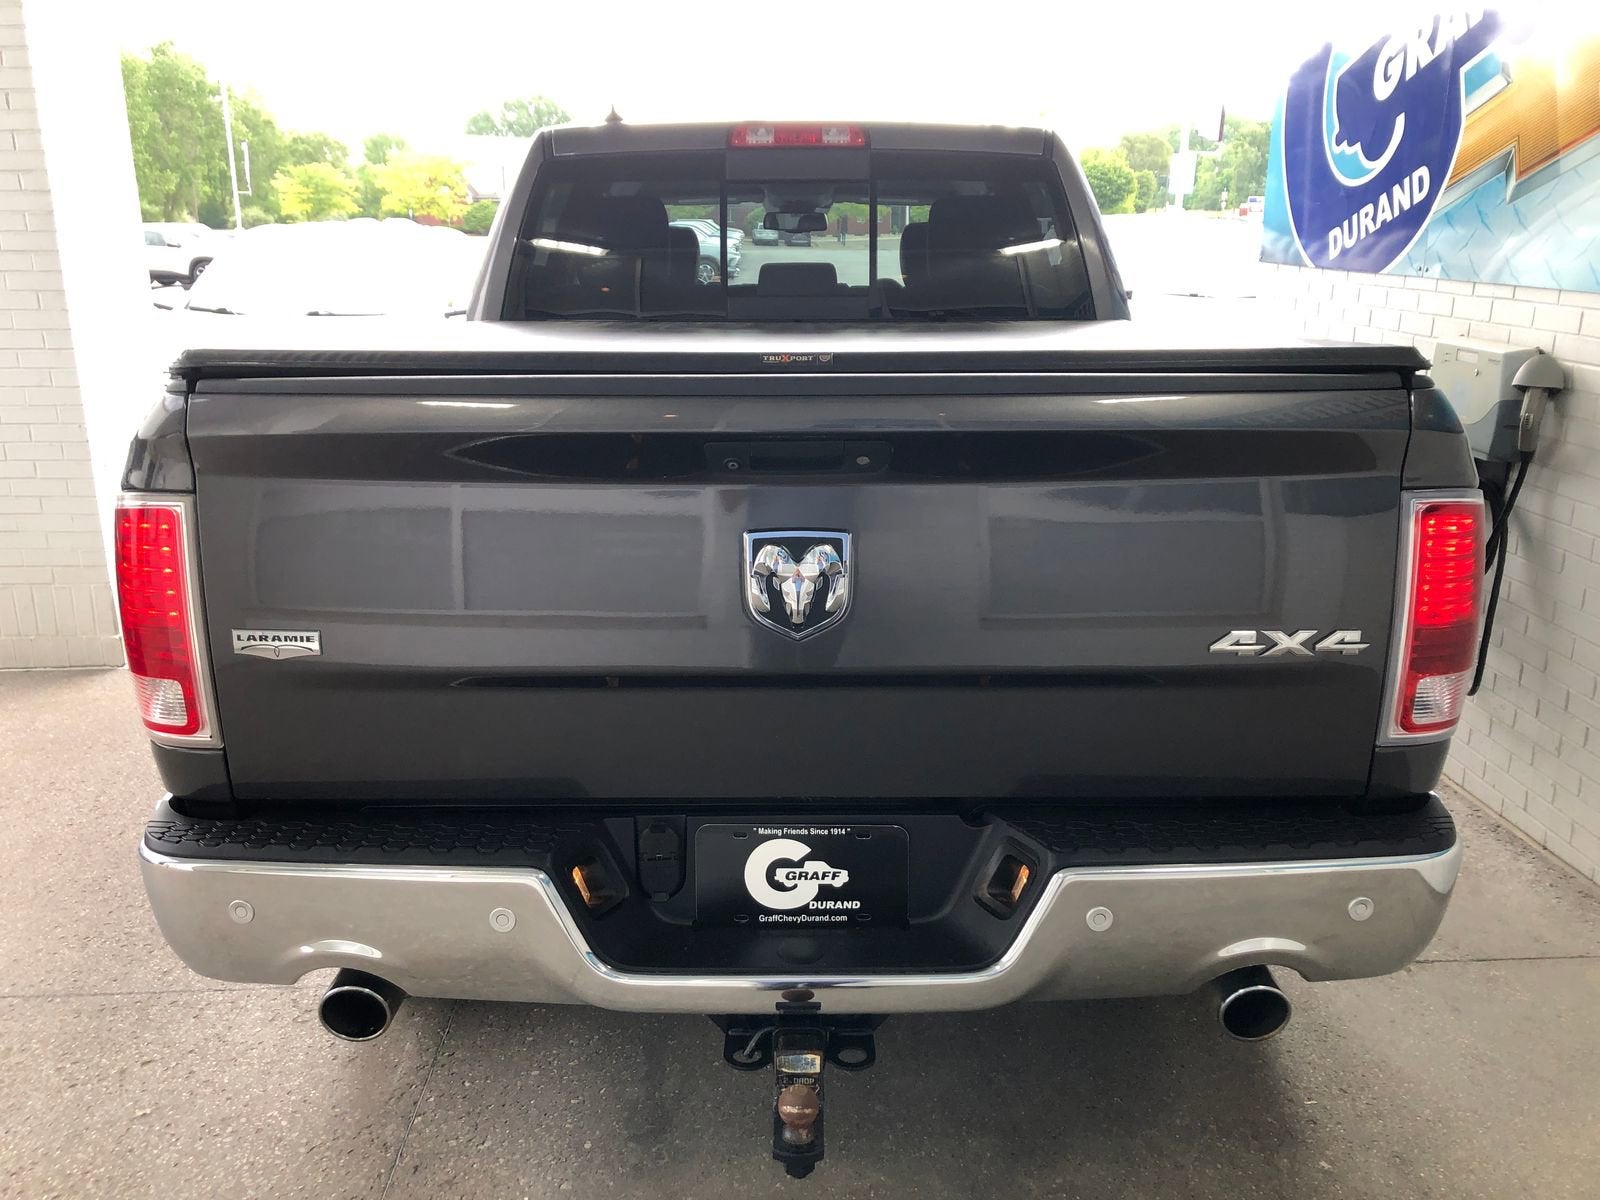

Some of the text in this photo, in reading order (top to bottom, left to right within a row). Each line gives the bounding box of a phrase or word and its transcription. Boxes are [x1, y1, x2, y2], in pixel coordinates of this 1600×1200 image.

[1327, 165, 1431, 261] DURAND
[762, 354, 814, 363] TRUXPORT
[236, 634, 316, 643] LARAMIE
[1209, 630, 1371, 657] 4X4
[758, 827, 782, 836] Making
[783, 827, 809, 836] Friends
[810, 827, 829, 836] Since
[830, 827, 846, 836] 1914
[785, 870, 842, 881] GRAFF
[808, 900, 861, 910] DURAND
[758, 914, 848, 924] GraffChevyDurand.com
